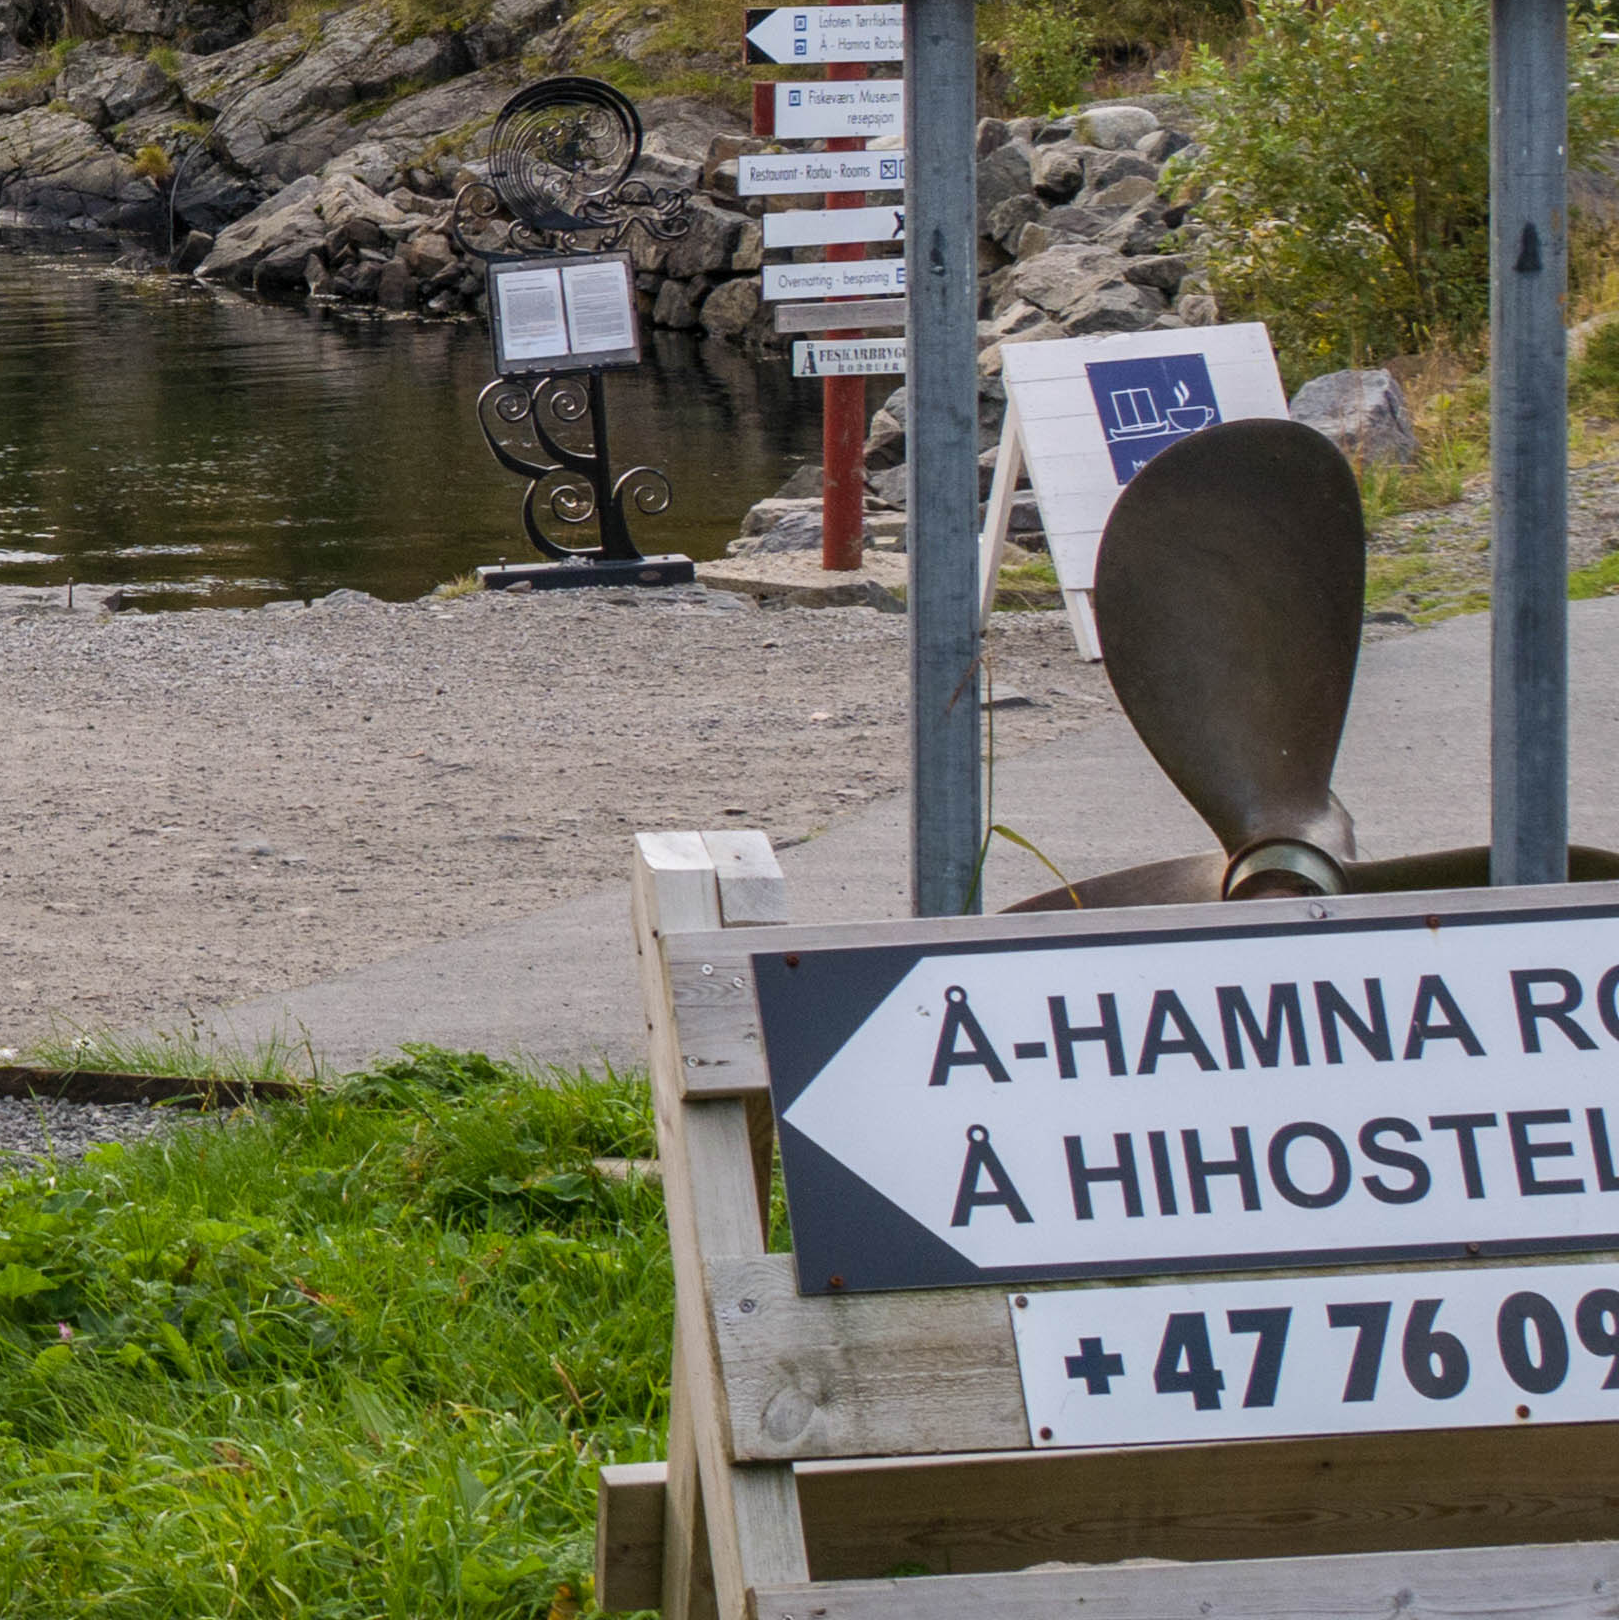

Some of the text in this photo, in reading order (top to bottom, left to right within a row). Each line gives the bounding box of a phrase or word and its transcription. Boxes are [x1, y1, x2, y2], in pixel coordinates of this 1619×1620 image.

[847, 112, 894, 128] resepsjon
[859, 88, 900, 103] Museum
[750, 167, 797, 181] Restaurant
[806, 164, 832, 179] Rorbu
[840, 163, 870, 177] Rooms
[928, 974, 1486, 1086] Å-HAMNA
[950, 1123, 1034, 1227] Å
[1326, 1298, 1471, 1403] 76
